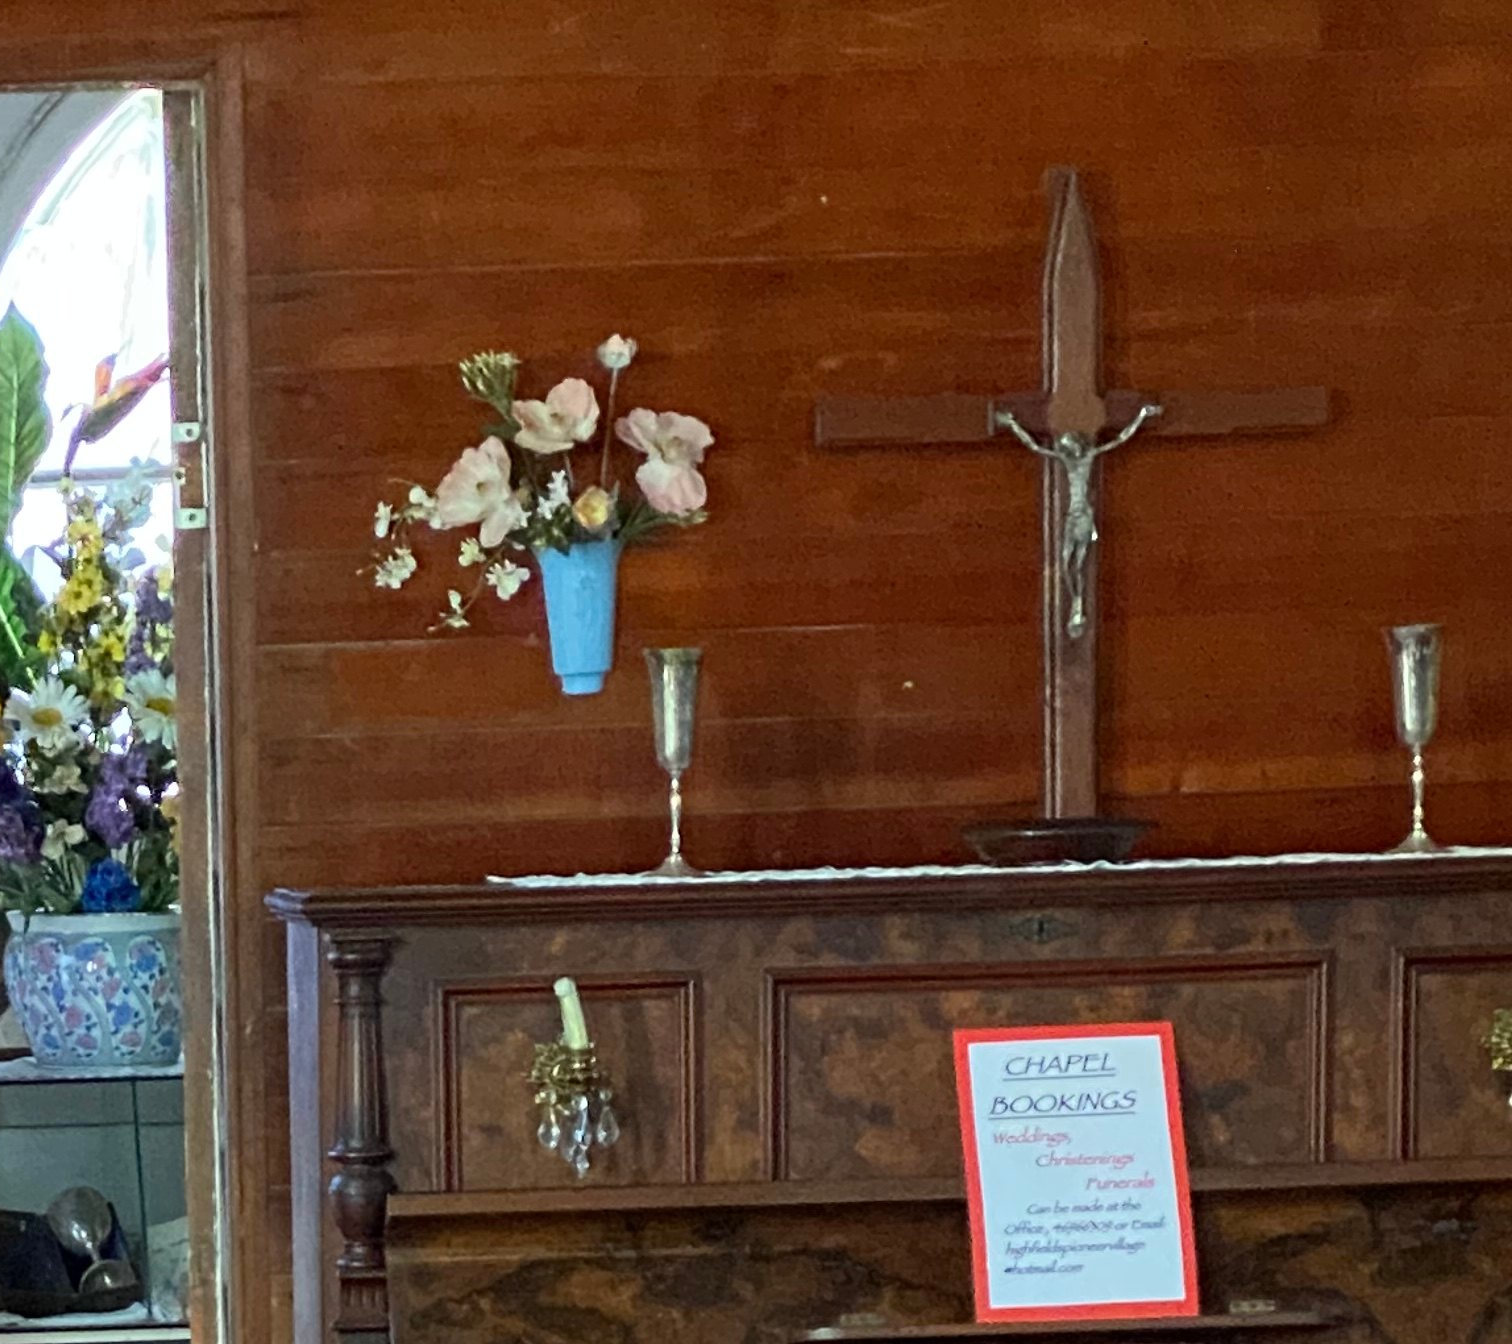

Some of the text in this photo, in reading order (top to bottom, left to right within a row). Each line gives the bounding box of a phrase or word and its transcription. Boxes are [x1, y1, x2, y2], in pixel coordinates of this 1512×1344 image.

[1005, 1052, 1117, 1076] CHAPEL
[989, 1089, 1138, 1116] BOOKINGS
[1085, 1169, 1156, 1190] Funerals
[1026, 1203, 1052, 1215] Can
[1053, 1199, 1070, 1213] be
[1071, 1197, 1104, 1213] made
[1121, 1196, 1141, 1211] the
